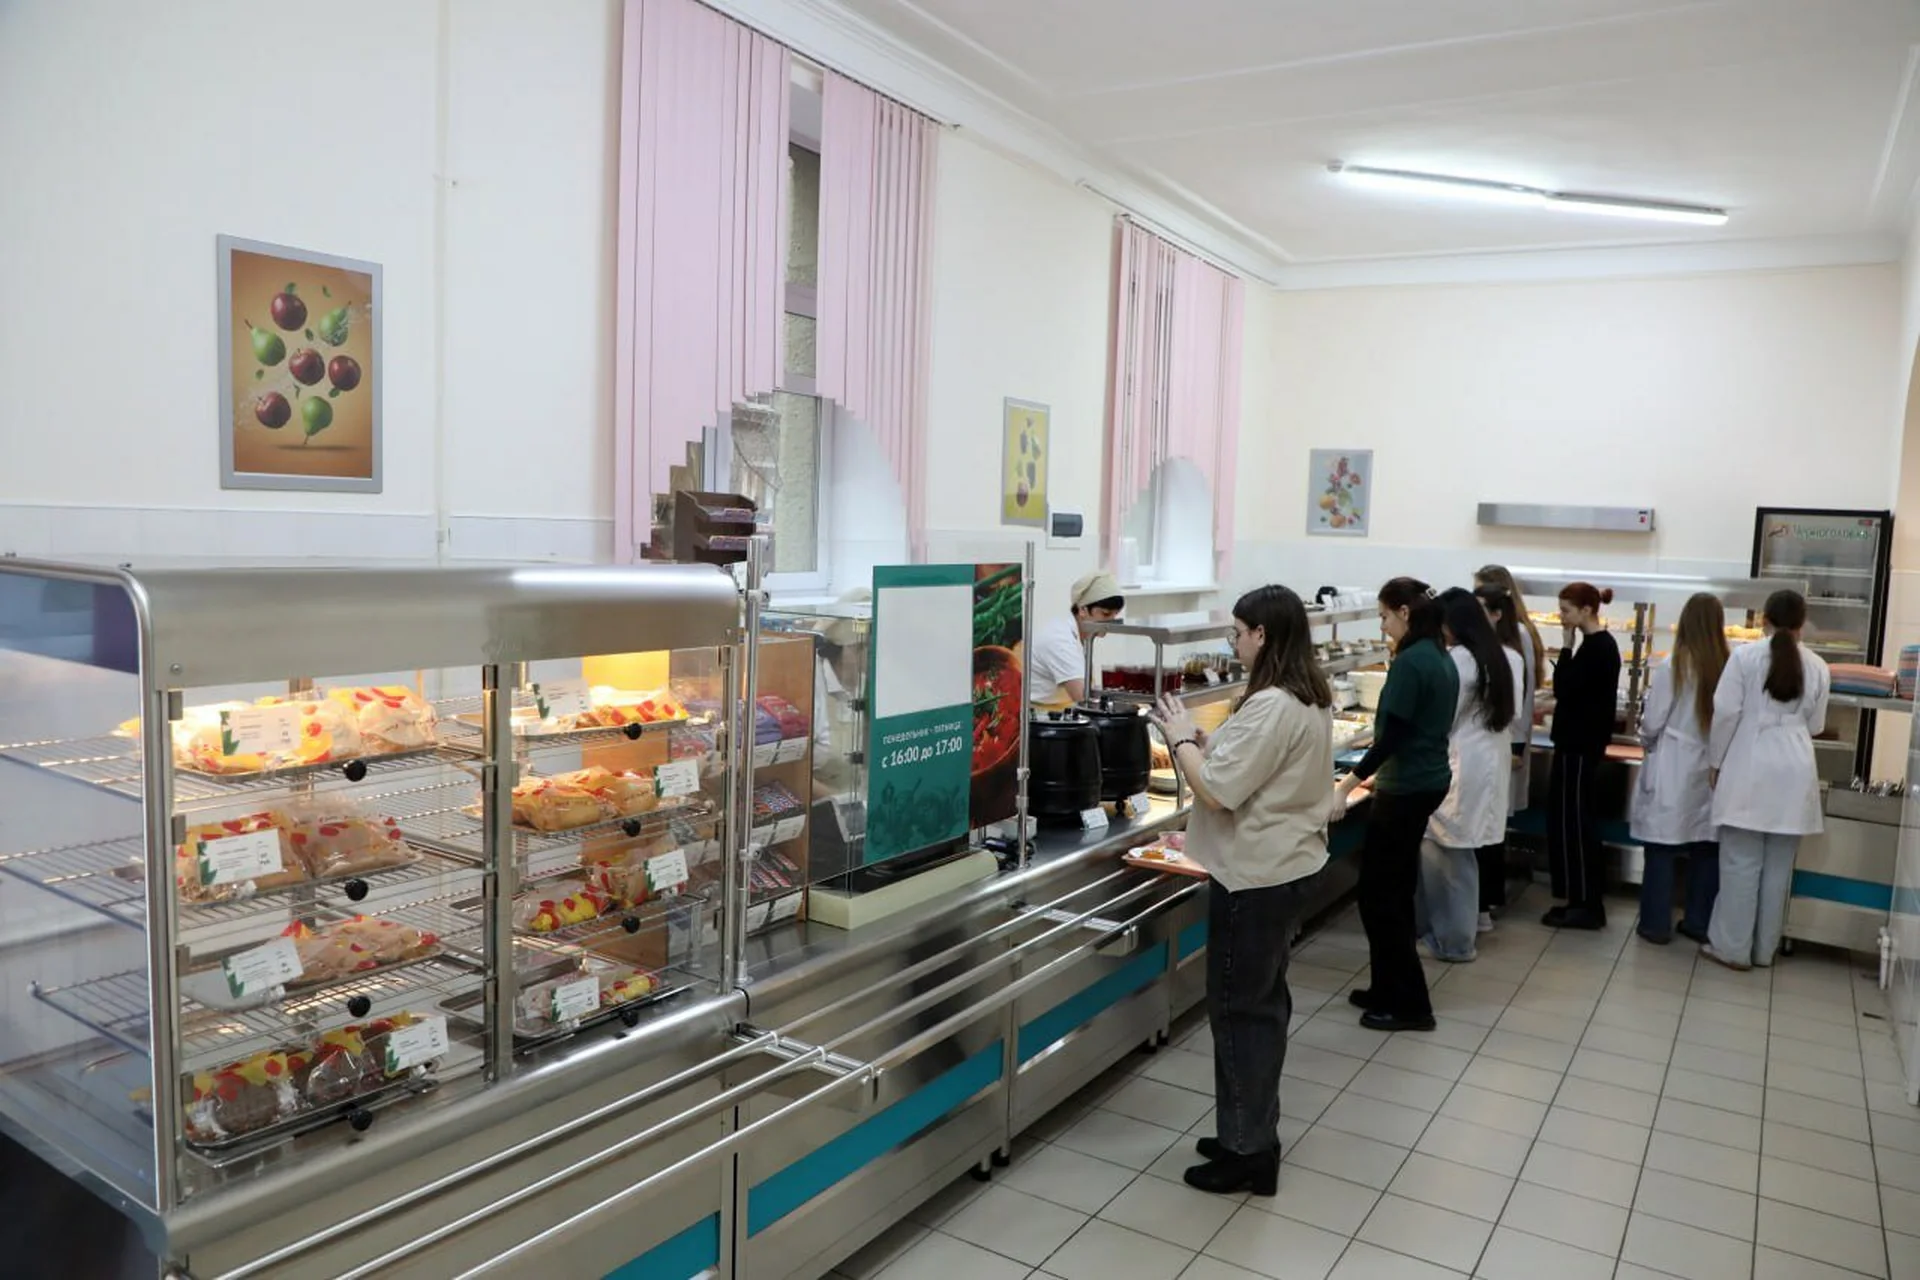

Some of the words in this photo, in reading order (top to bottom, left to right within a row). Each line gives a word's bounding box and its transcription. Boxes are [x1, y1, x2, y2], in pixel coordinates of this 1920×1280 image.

[881, 756, 888, 768] с
[890, 745, 919, 767] 16:00
[920, 746, 933, 762] до
[935, 736, 962, 756] 17:00
